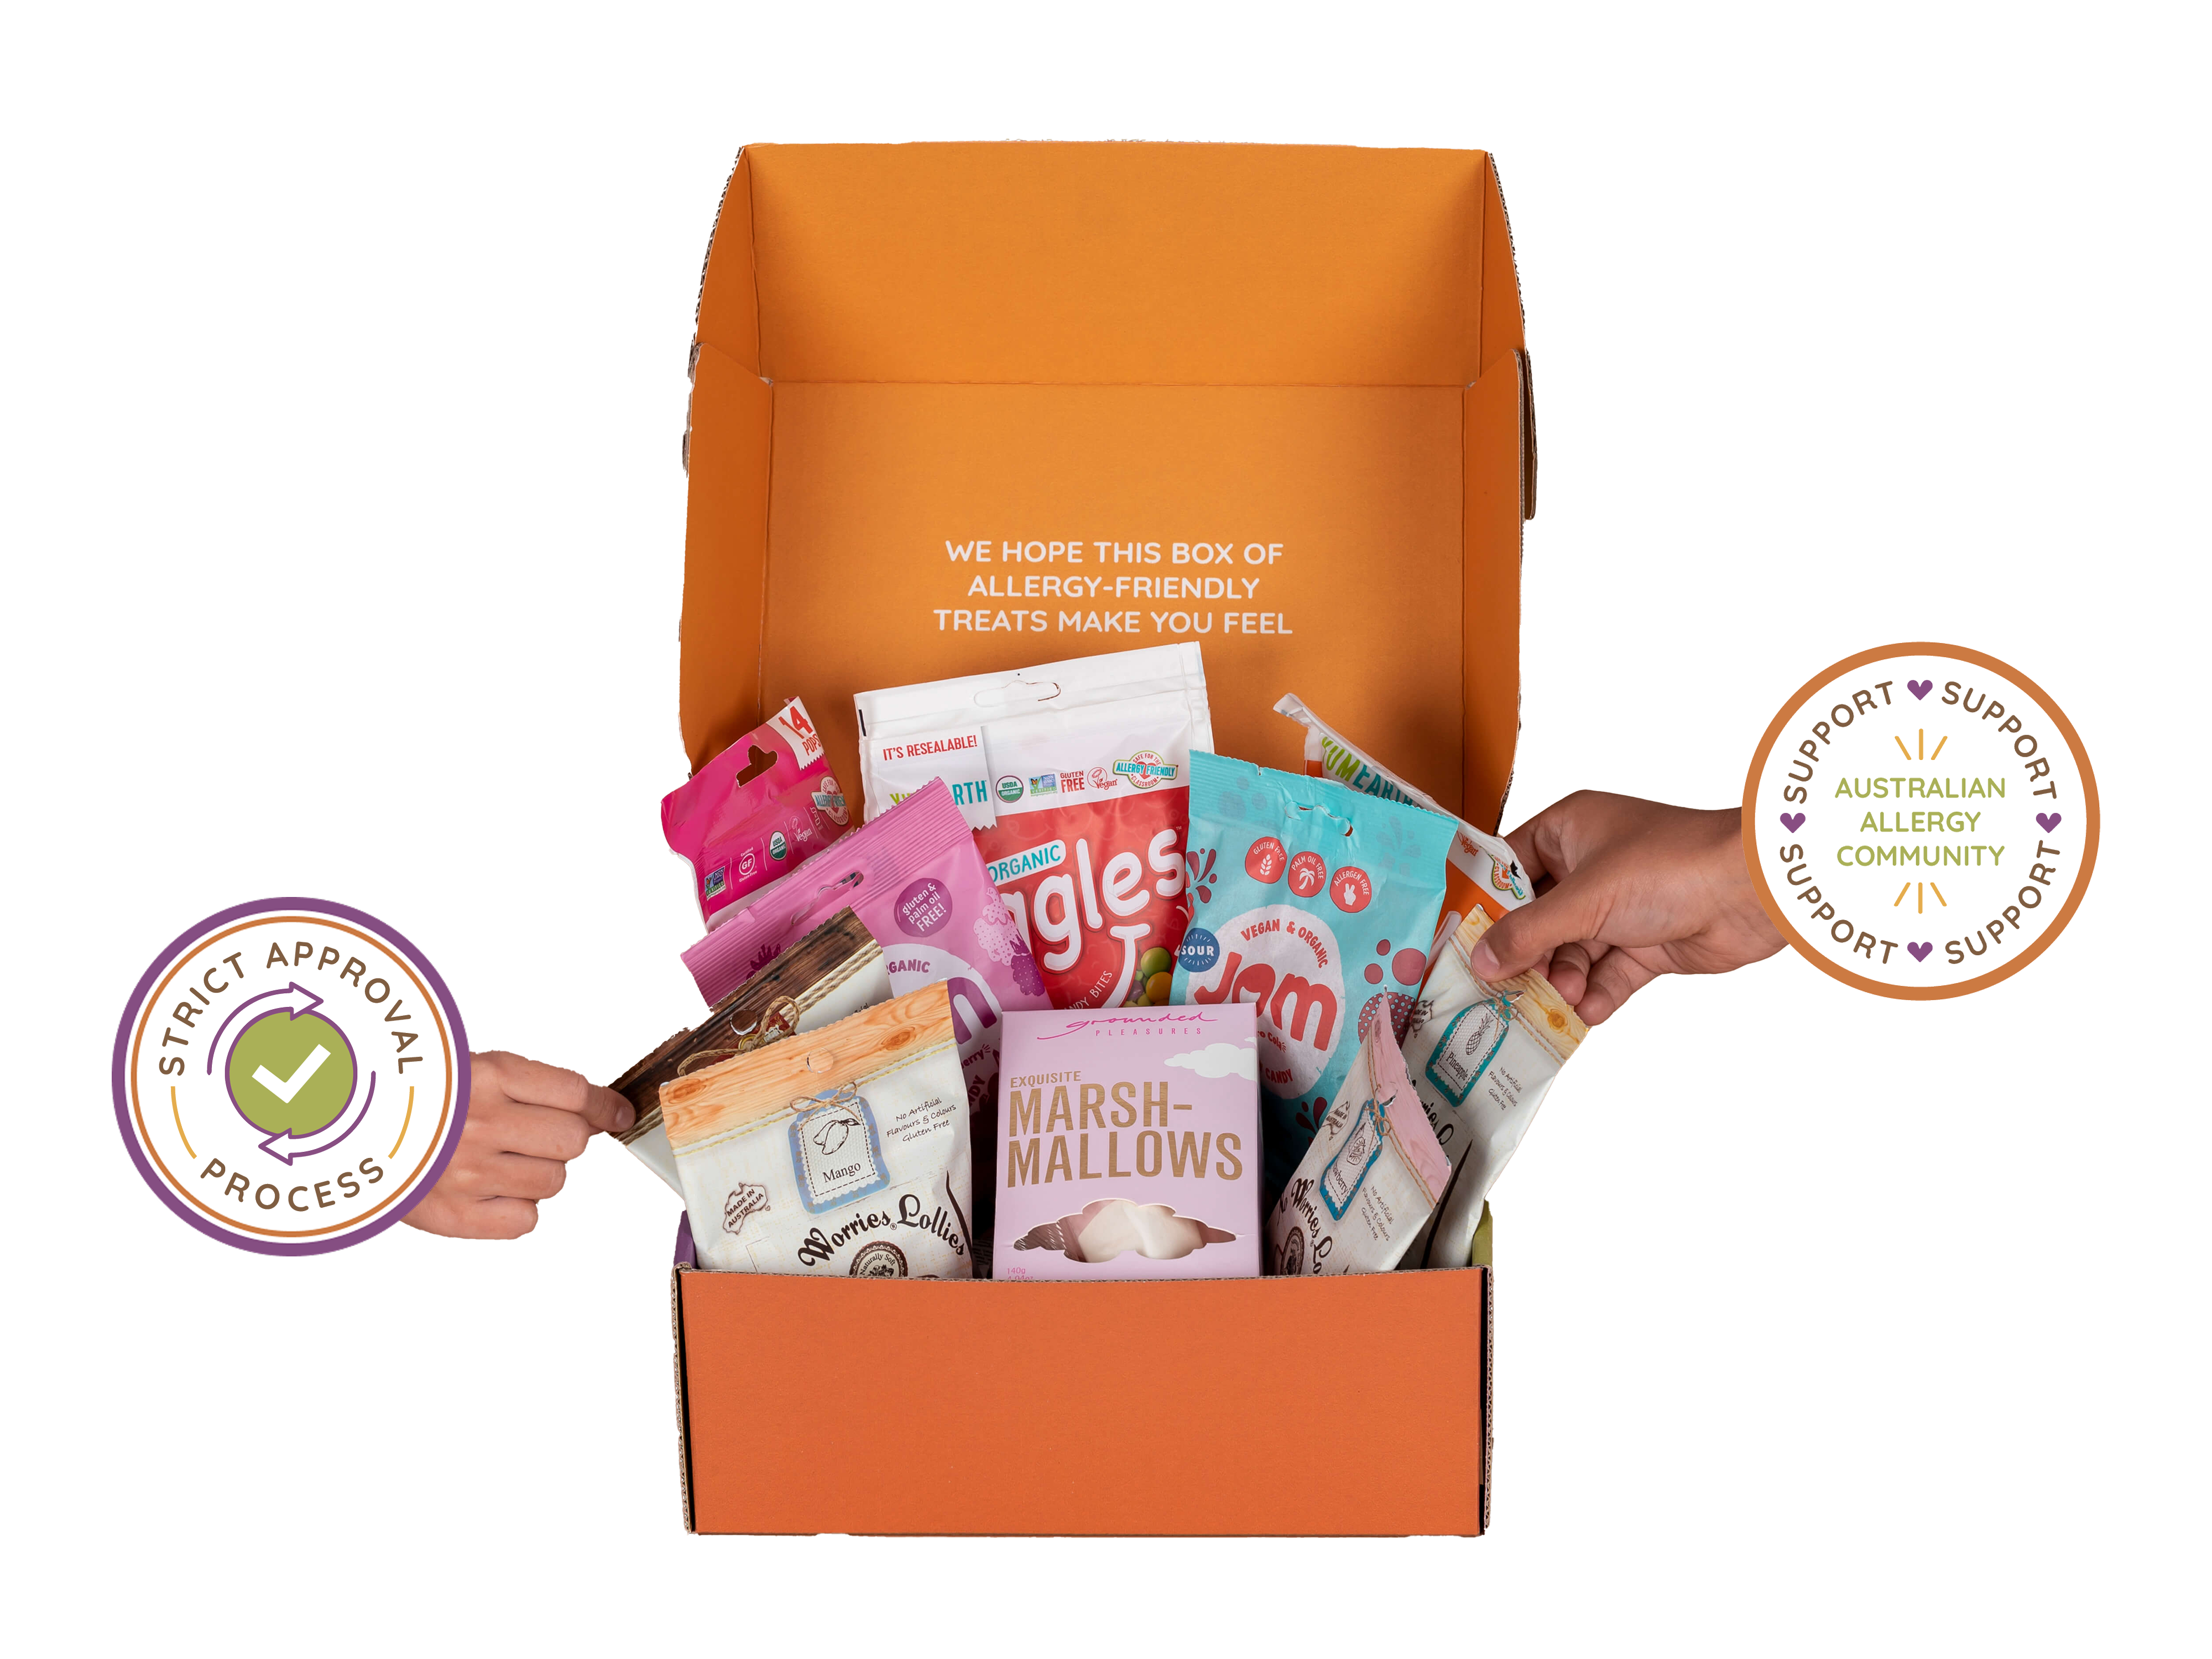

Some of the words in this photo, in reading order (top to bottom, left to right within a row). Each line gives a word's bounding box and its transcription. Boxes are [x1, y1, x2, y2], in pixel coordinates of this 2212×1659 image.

[945, 540, 992, 562] WE
[1002, 541, 1083, 563] HOPE
[1093, 541, 1161, 564] THIS
[1172, 542, 1233, 565] BOX
[1243, 543, 1284, 565] OF
[967, 575, 1260, 599] ALLERGY-FRIENDLY
[933, 609, 1047, 632] TREATS
[1058, 611, 1141, 633] MAKE
[1150, 611, 1212, 634] YOU
[1224, 612, 1293, 634] FEEL
[778, 706, 813, 739] 14
[802, 734, 821, 756] POPS
[883, 747, 904, 761] IT'S
[906, 735, 978, 757] RESEALABLE!
[1116, 762, 1145, 774] ALLERGY
[1146, 764, 1175, 776] FRIENDLY
[1133, 753, 1144, 764] SAFE
[1001, 781, 1018, 789] USDA
[1061, 778, 1085, 793] FREE
[1093, 778, 1118, 790] Vegan
[1131, 775, 1157, 787] CLASSROOM
[773, 837, 783, 847] USDA
[795, 827, 813, 842] Vegan
[740, 847, 754, 857] Certified
[742, 858, 753, 870] GF
[987, 844, 1061, 883] ORGANIC
[1253, 842, 1274, 855] GLUTEN
[1275, 846, 1285, 862] FREE
[739, 870, 758, 883] Gluten-Free
[1291, 855, 1306, 870] PALM
[1307, 855, 1316, 865] OIL
[1316, 862, 1324, 879] FREE
[1334, 870, 1362, 886] ALLERGEN
[1359, 878, 1369, 895] FREE
[902, 889, 929, 916] gluten
[927, 883, 936, 891] &
[908, 903, 929, 925] palm
[929, 891, 940, 904] oil
[916, 902, 946, 932] FREE!
[1181, 946, 1214, 957] SOUR
[1240, 919, 1280, 941] VEGAN
[1286, 921, 1296, 935] &
[1297, 926, 1328, 968] ORGANIC
[1089, 971, 1113, 998] BITES
[1036, 1011, 1219, 1040] grounded
[1095, 1027, 1202, 1037] PLEASURES
[1265, 1067, 1293, 1084] CANDY
[1446, 1051, 1469, 1081] Pineapple
[1499, 1066, 1506, 1076] No
[1010, 1070, 1082, 1088] EXQUISITE
[1488, 1071, 1505, 1091] Flavours
[1488, 1088, 1500, 1103] Gluten
[886, 1119, 921, 1138] Flavours
[931, 1104, 956, 1119] Colours
[895, 1113, 907, 1122] No
[908, 1097, 942, 1117] Artificial
[1009, 1081, 1193, 1138] MARSH-
[1334, 1108, 1344, 1119] MADE
[902, 1128, 932, 1142] Gluten
[933, 1120, 950, 1130] Free
[1326, 1115, 1344, 1129] AUSTRALIA
[1007, 1130, 1243, 1188] MALLOWS
[822, 1162, 862, 1183] Mango
[727, 1196, 747, 1217] MADE
[747, 1188, 755, 1198] IN
[728, 1193, 764, 1228] AUSTRALIA
[1291, 1178, 1321, 1239] Worries
[1362, 1187, 1375, 1214] Flavours
[1376, 1219, 1390, 1242] Colours
[1371, 1186, 1377, 1196] No
[1376, 1196, 1394, 1224] Artificial
[797, 1211, 891, 1266] Worries
[897, 1194, 965, 1256] Lollies
[860, 1253, 883, 1276] Naturally
[884, 1252, 896, 1266] Soft
[1008, 1266, 1026, 1275] 140g
